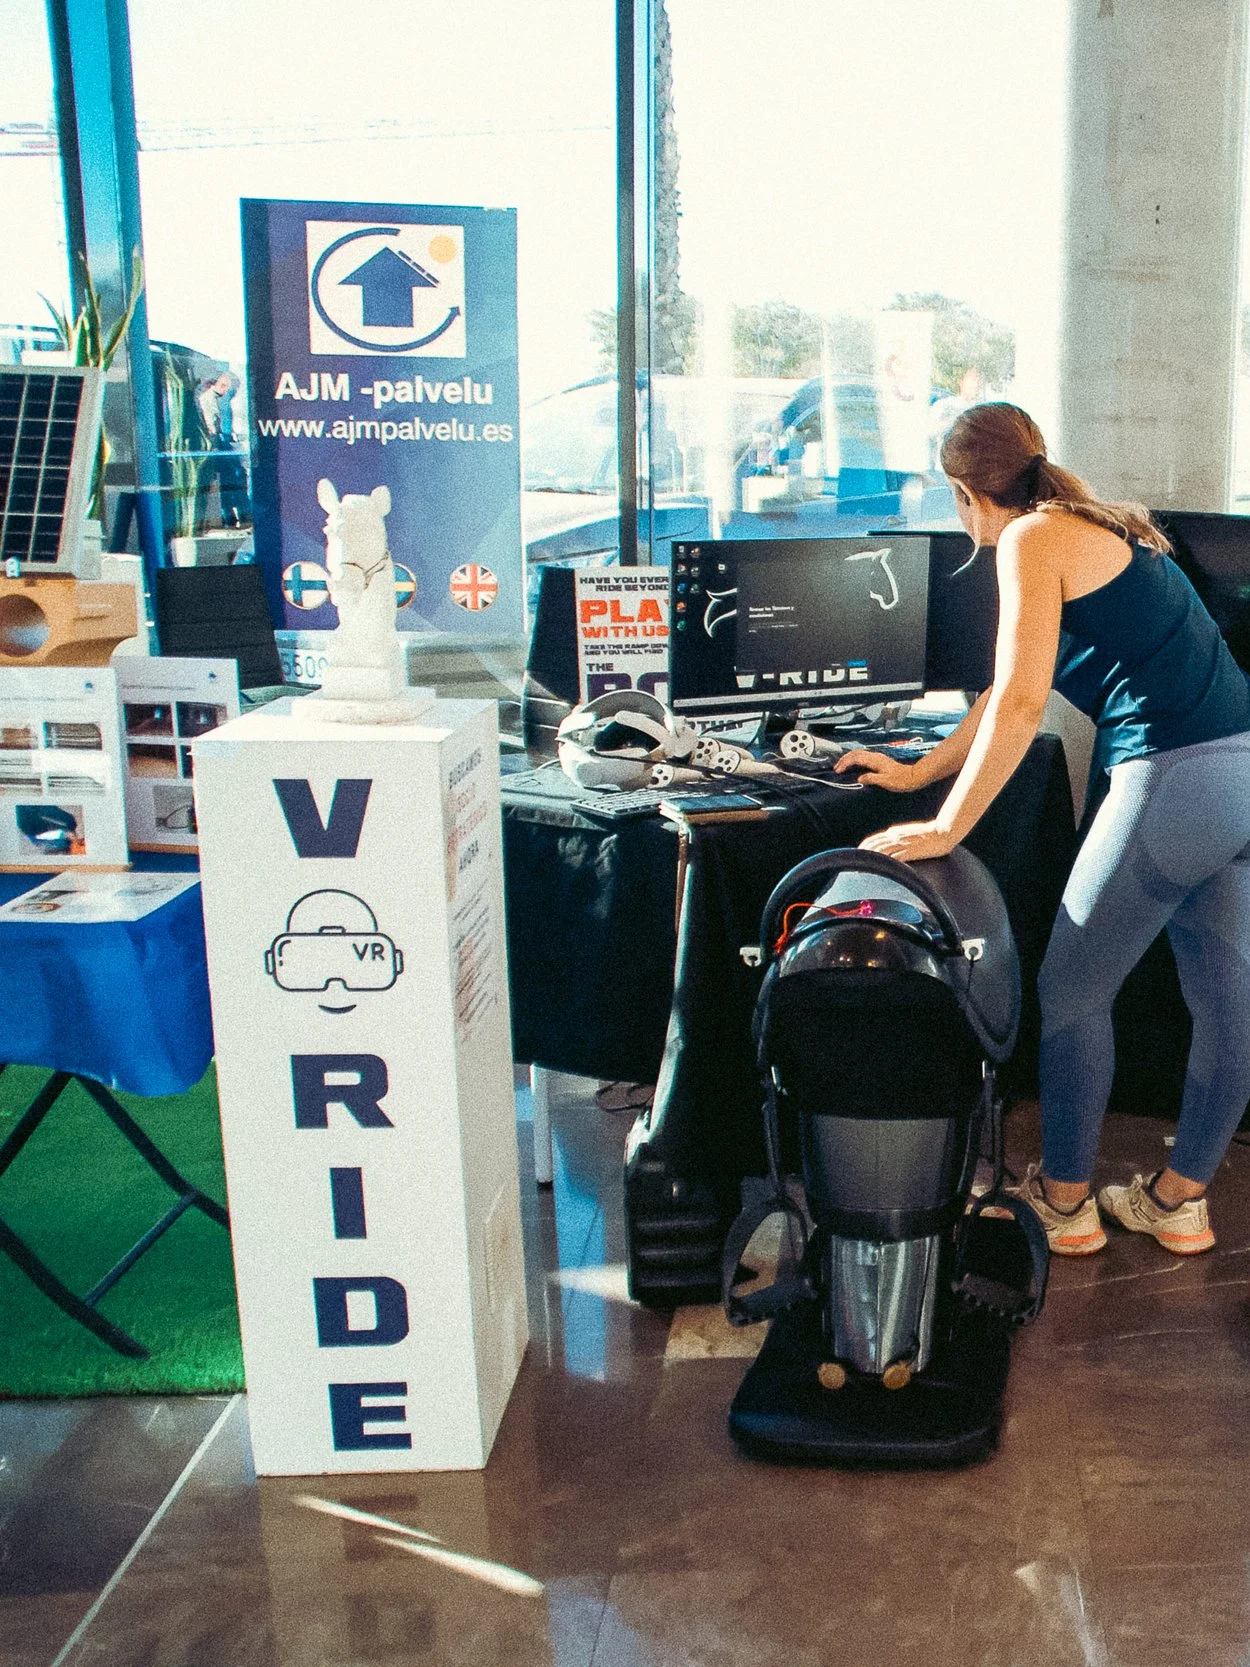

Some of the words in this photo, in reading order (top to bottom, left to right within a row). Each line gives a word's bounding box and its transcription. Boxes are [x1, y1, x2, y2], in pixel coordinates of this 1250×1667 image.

[274, 372, 351, 402] AJM
[257, 415, 514, 446] www.ajmpalvelu.es
[580, 576, 611, 584] HAVE
[613, 576, 638, 584] YOU
[595, 584, 622, 592] RIDE
[580, 598, 669, 624] PLA
[582, 625, 638, 638] WITH
[641, 625, 669, 637] US
[586, 663, 614, 672] THE
[352, 942, 385, 961] VR
